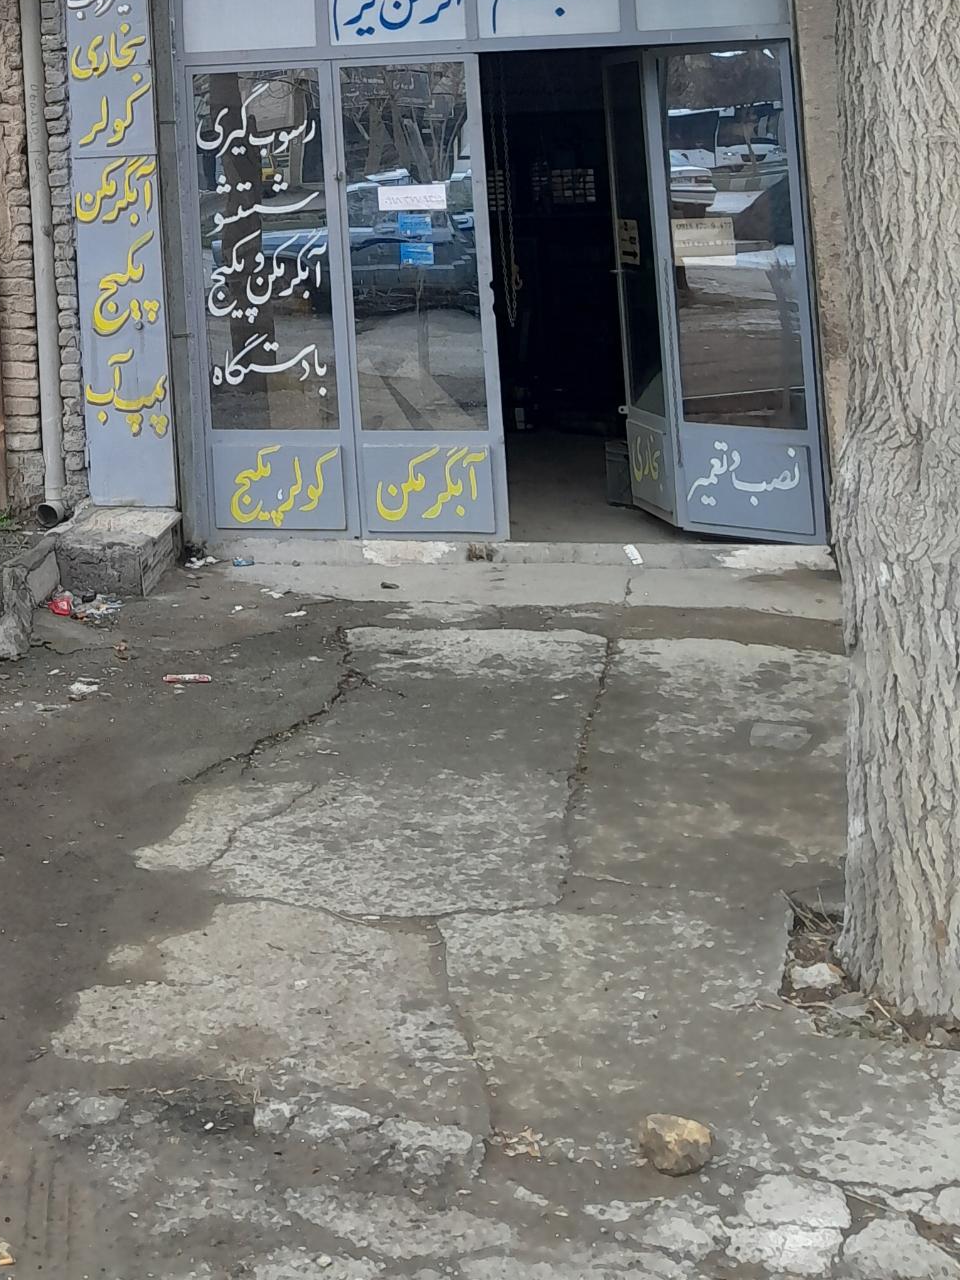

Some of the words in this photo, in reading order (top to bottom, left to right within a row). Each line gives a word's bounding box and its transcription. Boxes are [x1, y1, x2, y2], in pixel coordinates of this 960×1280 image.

[70, 22, 147, 84] بخاری
[79, 83, 152, 147] کولر
[196, 82, 269, 159] گیری
[248, 118, 316, 156] رسوب
[75, 155, 157, 224] آبگرمکن
[206, 173, 320, 237] شستشو
[92, 230, 160, 335] پکیج
[207, 229, 261, 324] پکیج
[246, 227, 329, 305] آبگرمکن
[212, 332, 317, 386] دستگاه
[230, 444, 284, 528] پکیج
[278, 447, 339, 512] کولر
[375, 444, 489, 521] آبگرمکن
[687, 440, 729, 507] تعمیر
[731, 447, 800, 507] نصب
